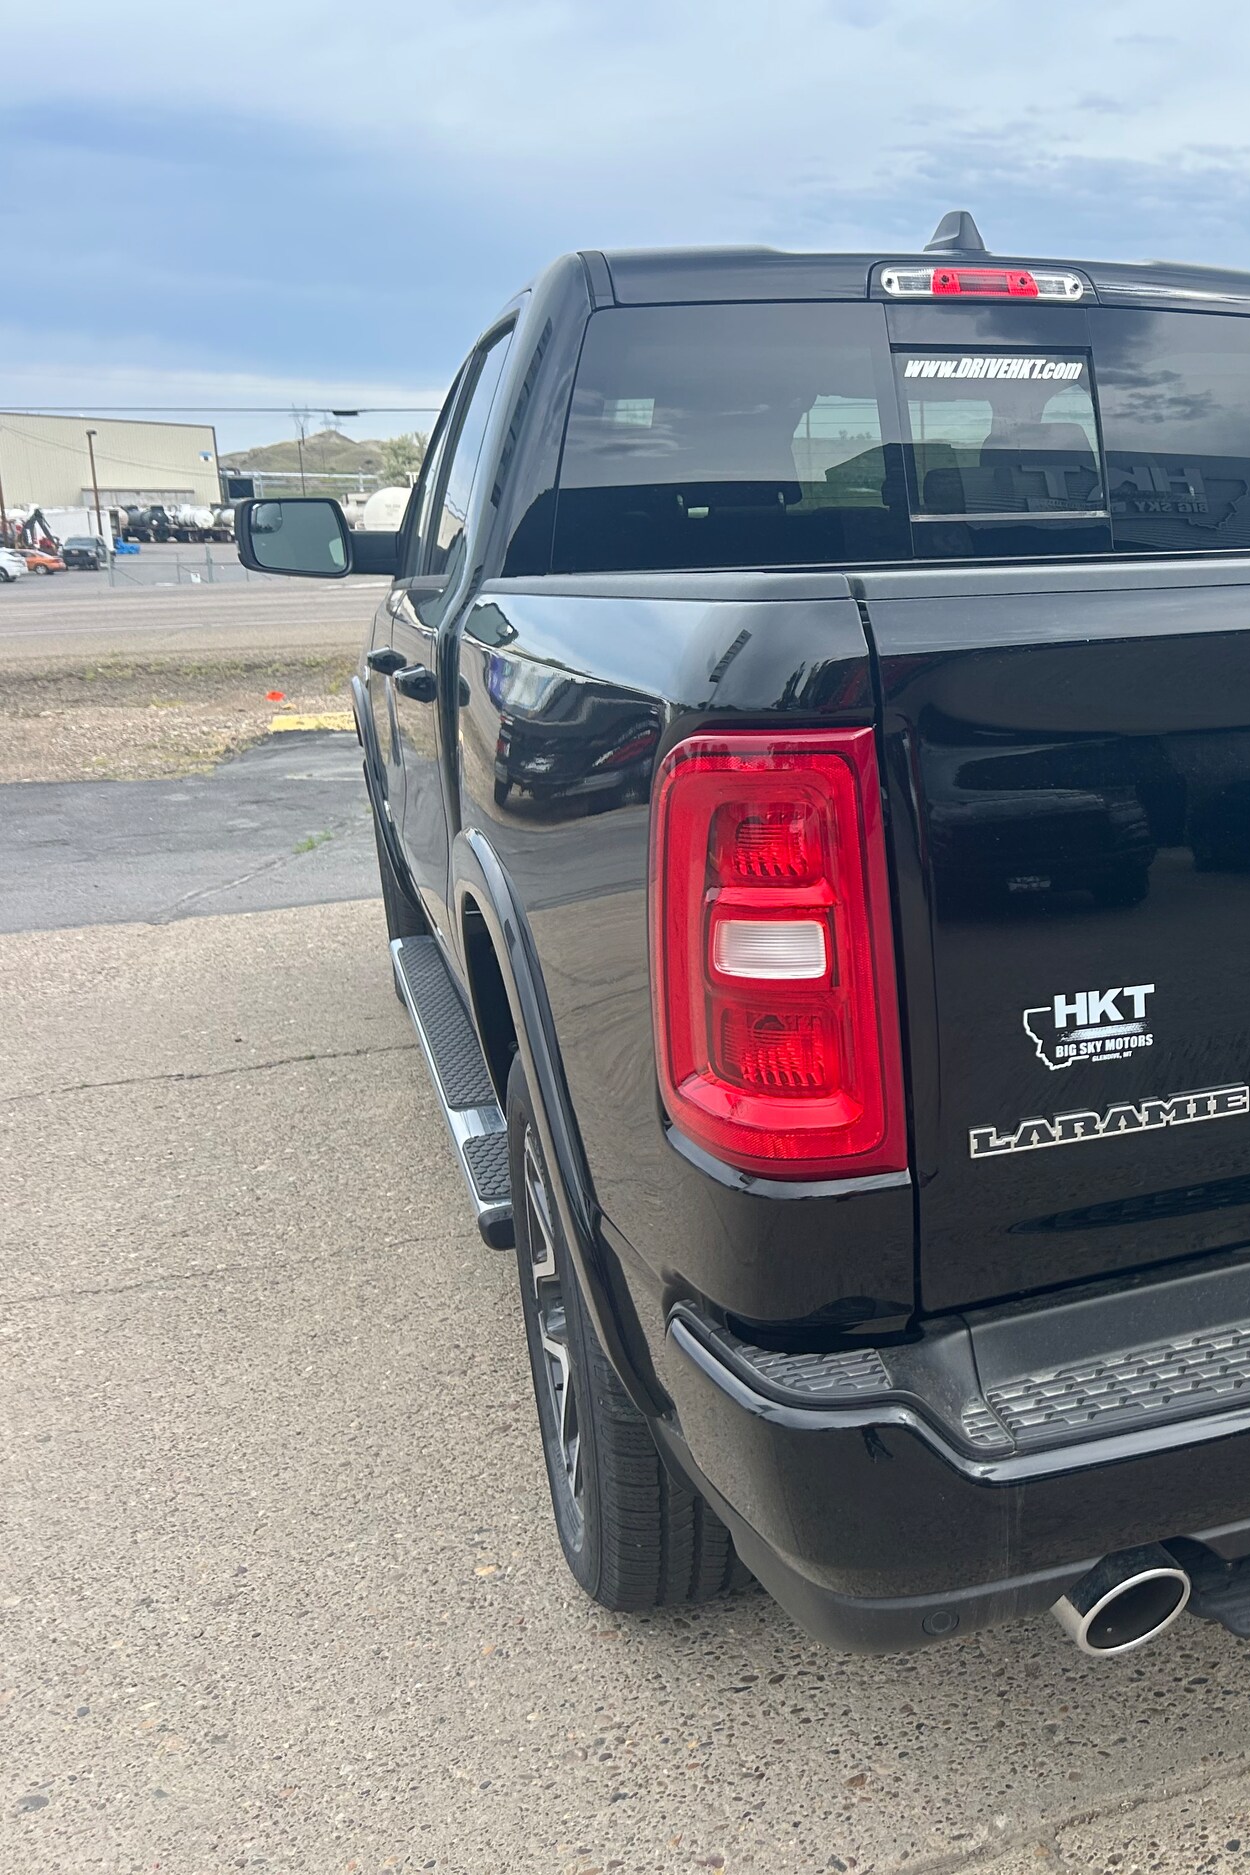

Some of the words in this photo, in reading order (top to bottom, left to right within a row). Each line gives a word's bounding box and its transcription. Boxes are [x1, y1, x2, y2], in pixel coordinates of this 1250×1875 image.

[904, 357, 1083, 380] www.DRIVEHKT.com
[1054, 984, 1155, 1028] HKT
[1055, 1044, 1077, 1058] BIG
[1079, 1040, 1103, 1055] SKY
[1105, 1034, 1154, 1051] MOTORS
[969, 1086, 1249, 1159] LARAMIE
